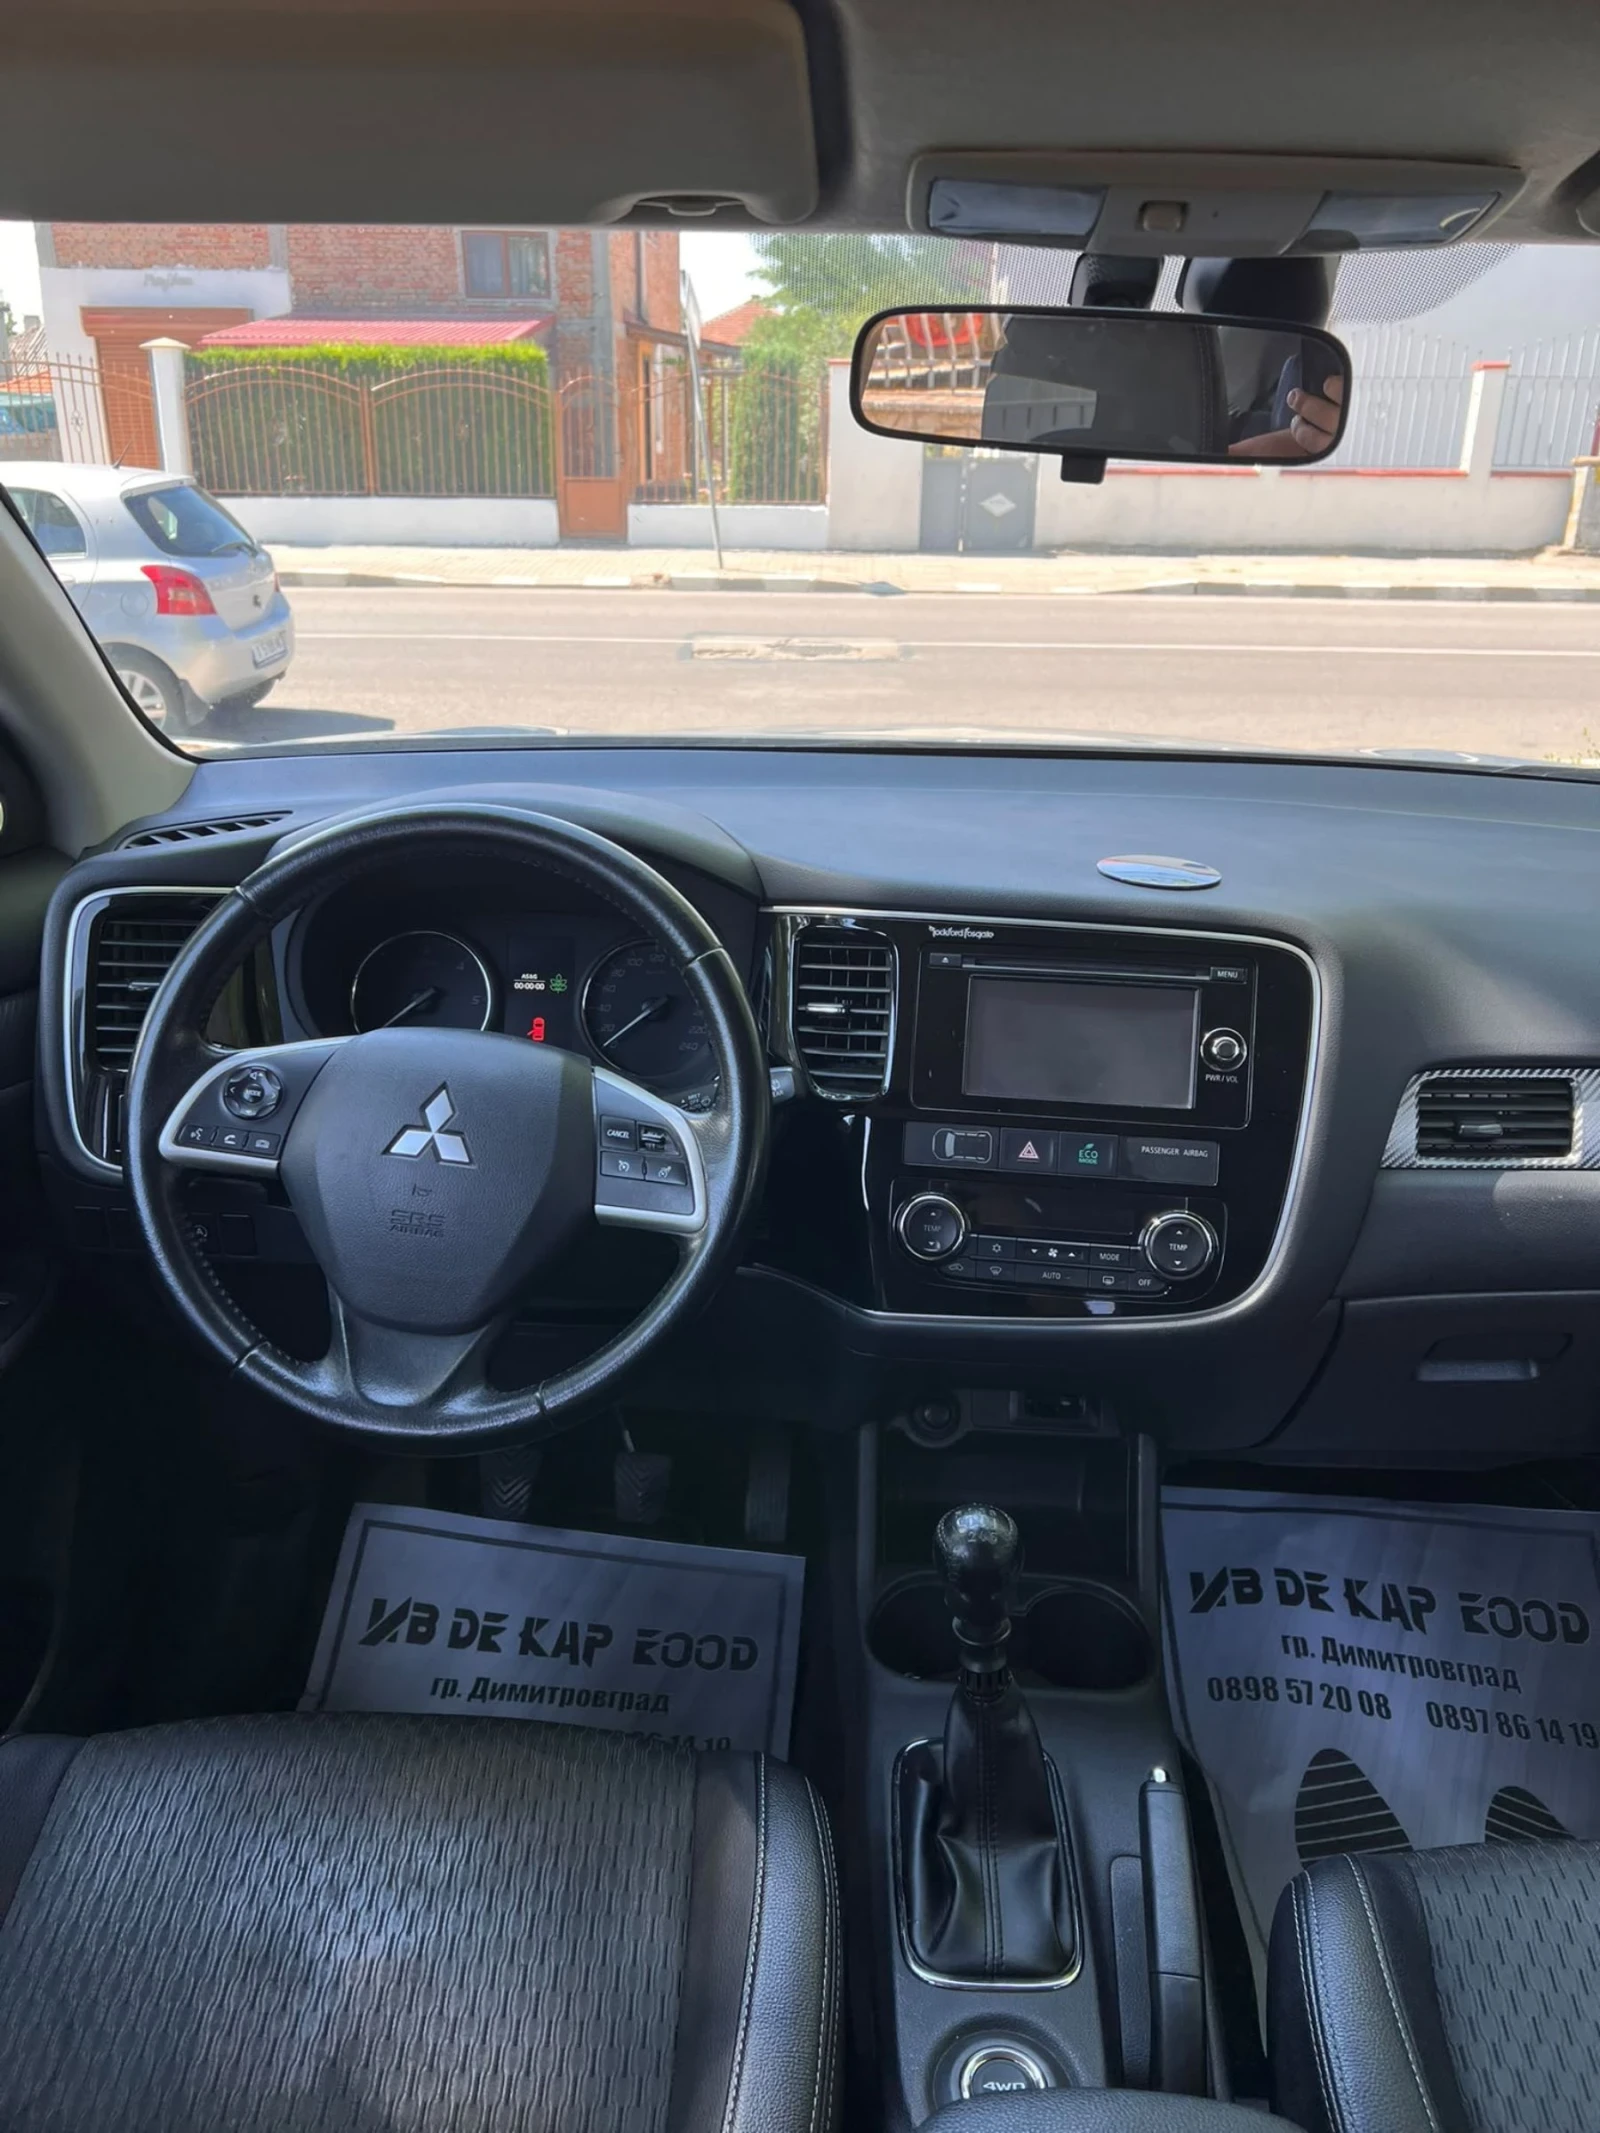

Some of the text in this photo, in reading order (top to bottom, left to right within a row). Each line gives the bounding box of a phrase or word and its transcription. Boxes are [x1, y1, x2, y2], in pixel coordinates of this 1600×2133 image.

[1216, 970, 1239, 979] MENU
[606, 1128, 630, 1139] CANCEL
[1078, 1149, 1099, 1159] ECO
[1140, 1145, 1209, 1158] PASSENGER AIRBAG
[390, 1208, 445, 1227] SRS
[923, 1224, 942, 1233] TEMP
[1168, 1242, 1188, 1252] TEMP
[1099, 1251, 1120, 1262] MODE
[1041, 1270, 1062, 1280] AUTO
[1137, 1277, 1152, 1287] OFF
[1281, 1634, 1522, 1695] гр. Димитровград
[429, 1676, 671, 1715] гр. Димитровград
[1207, 1676, 1393, 1721] 0898 57 20 08
[1425, 1701, 1600, 1750] 0897 86 14 19
